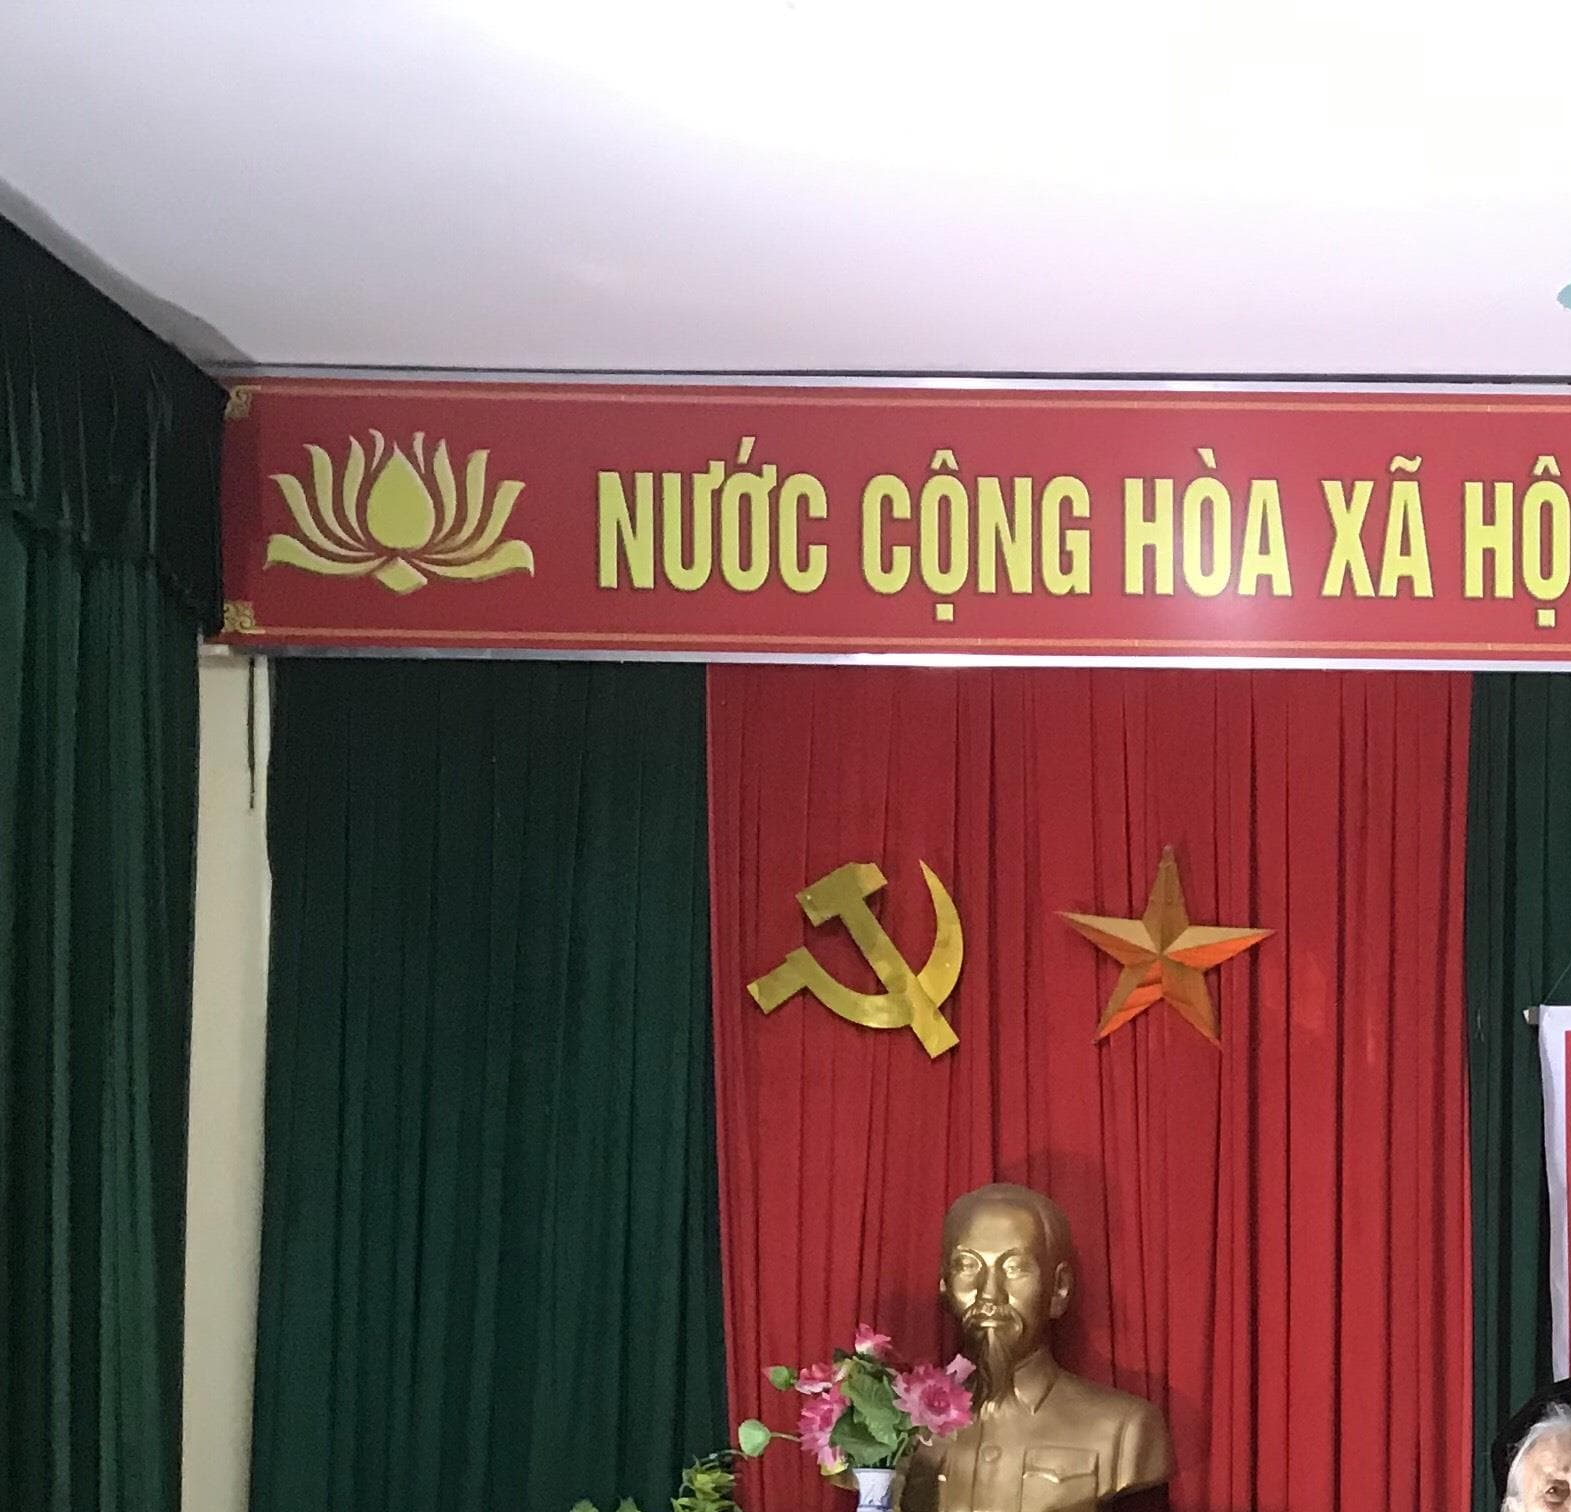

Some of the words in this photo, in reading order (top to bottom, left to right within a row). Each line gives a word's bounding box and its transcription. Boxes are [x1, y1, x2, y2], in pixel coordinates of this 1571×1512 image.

[599, 436, 828, 593] NƯỚC
[862, 449, 1091, 621] CỘNG
[1124, 447, 1293, 597] HÒA
[1321, 455, 1434, 598] XÃ
